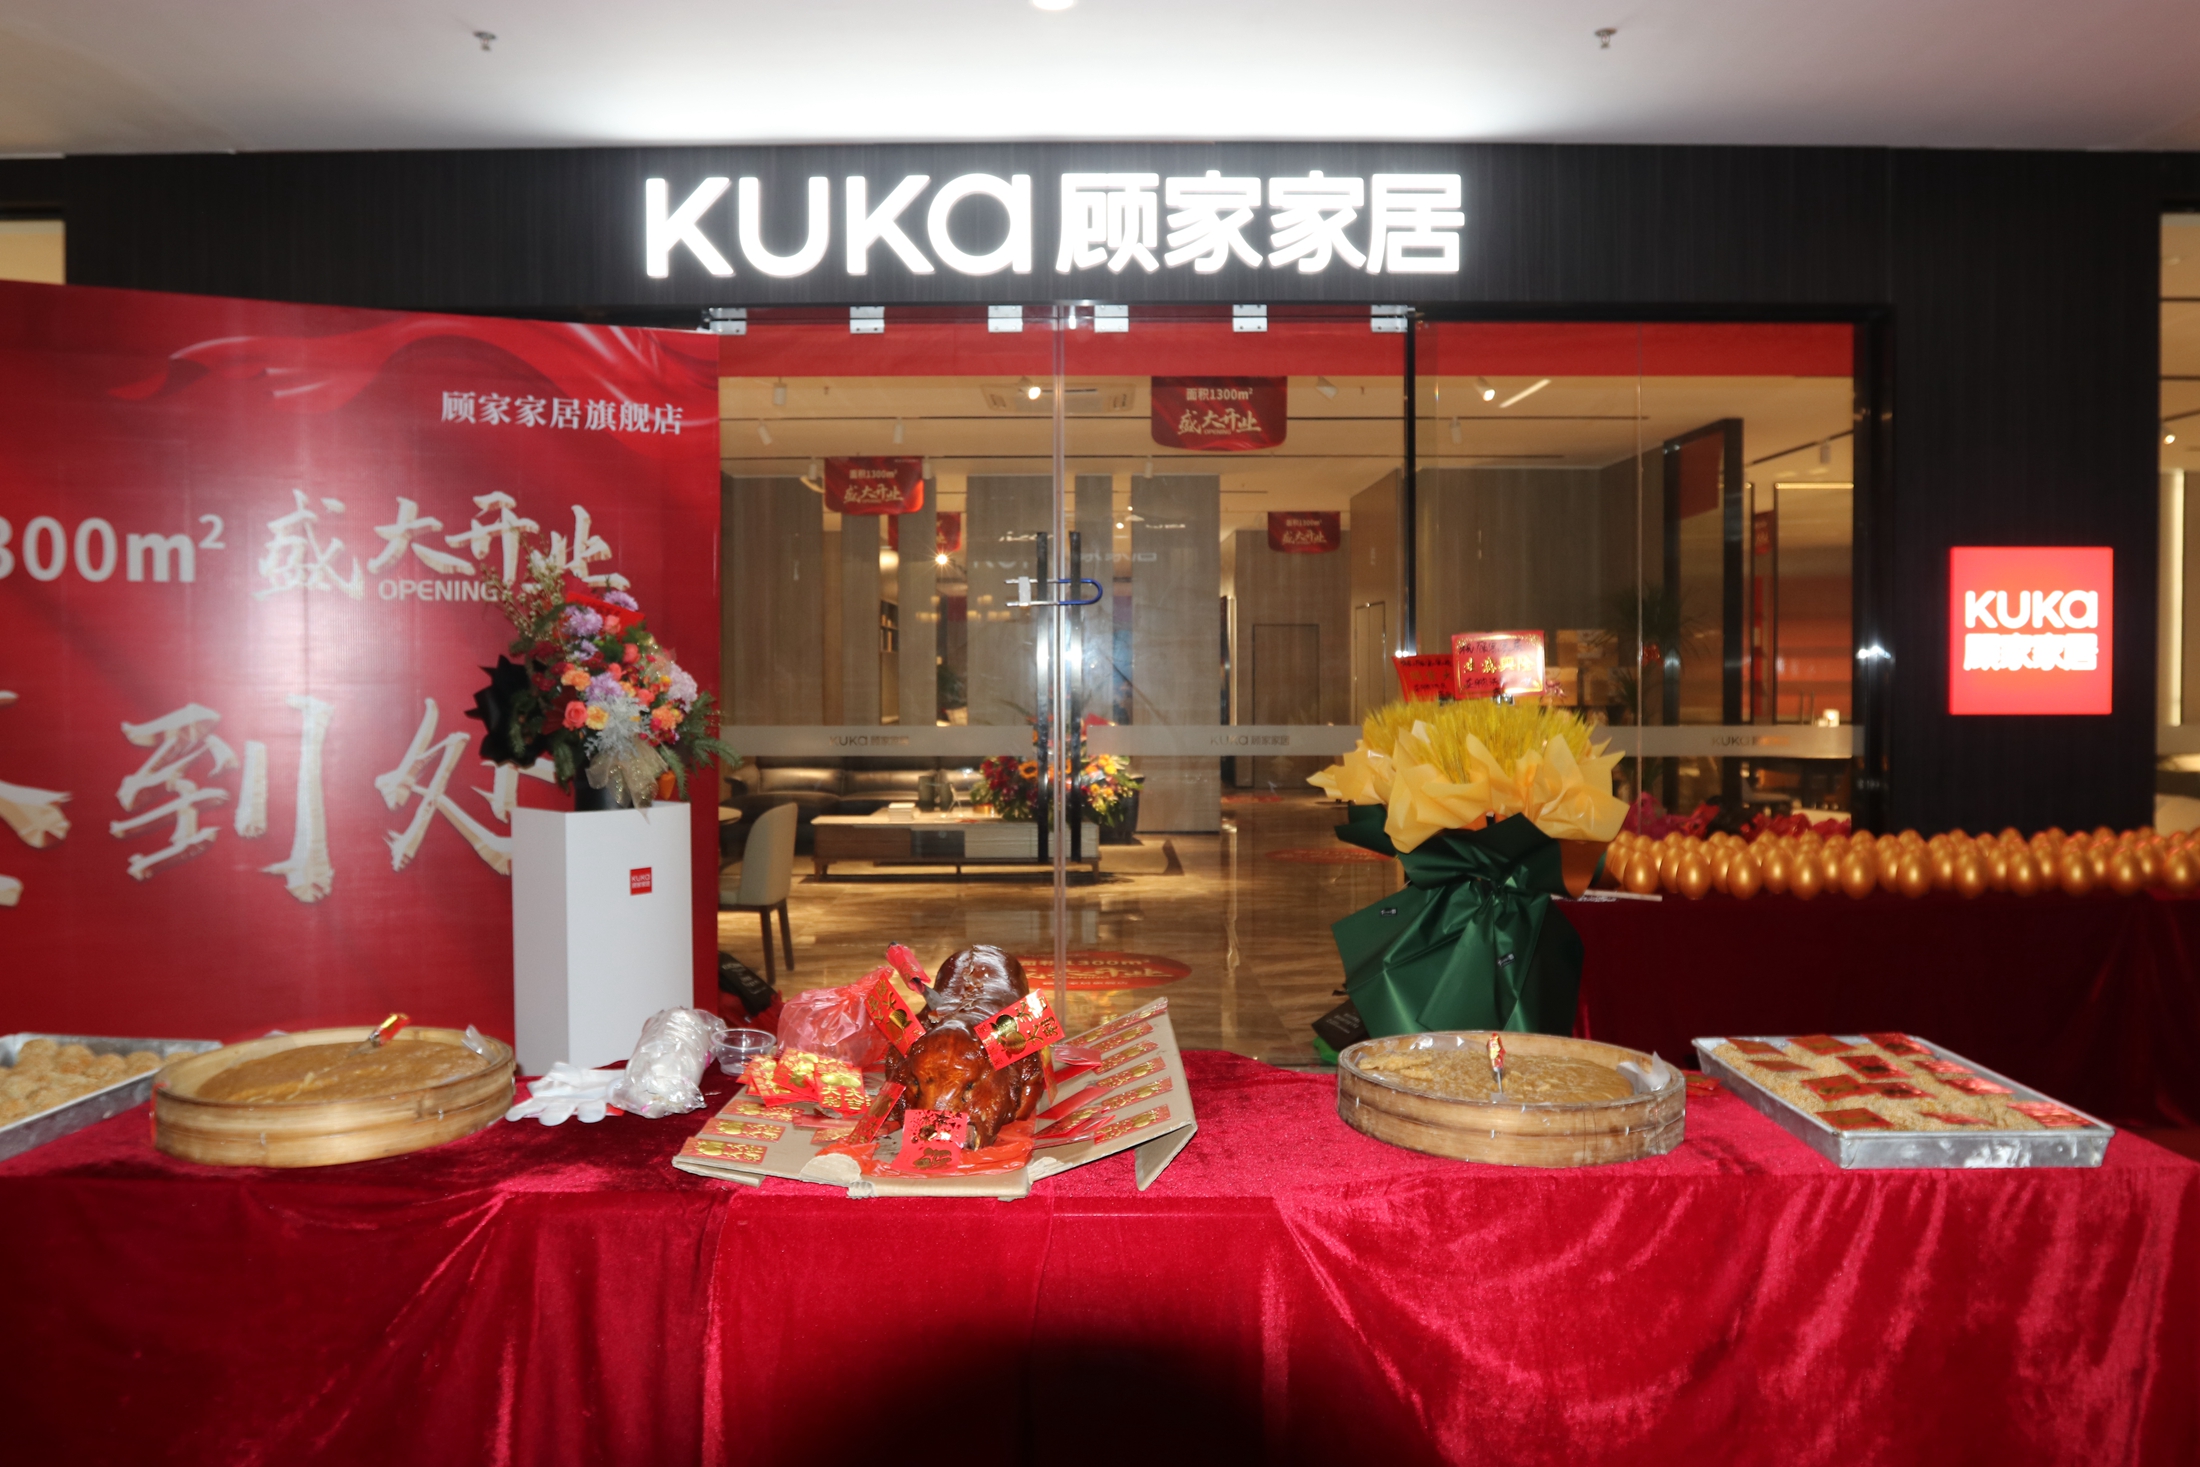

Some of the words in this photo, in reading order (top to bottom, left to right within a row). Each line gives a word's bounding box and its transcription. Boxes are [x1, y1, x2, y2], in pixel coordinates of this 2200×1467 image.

[1056, 170, 1466, 275] 顾家家居
[441, 390, 684, 435] 顾家家居旗舰店
[1178, 407, 1262, 435] 盛大开业
[253, 489, 631, 602] 盛大开业
[378, 579, 500, 601] OPENING
